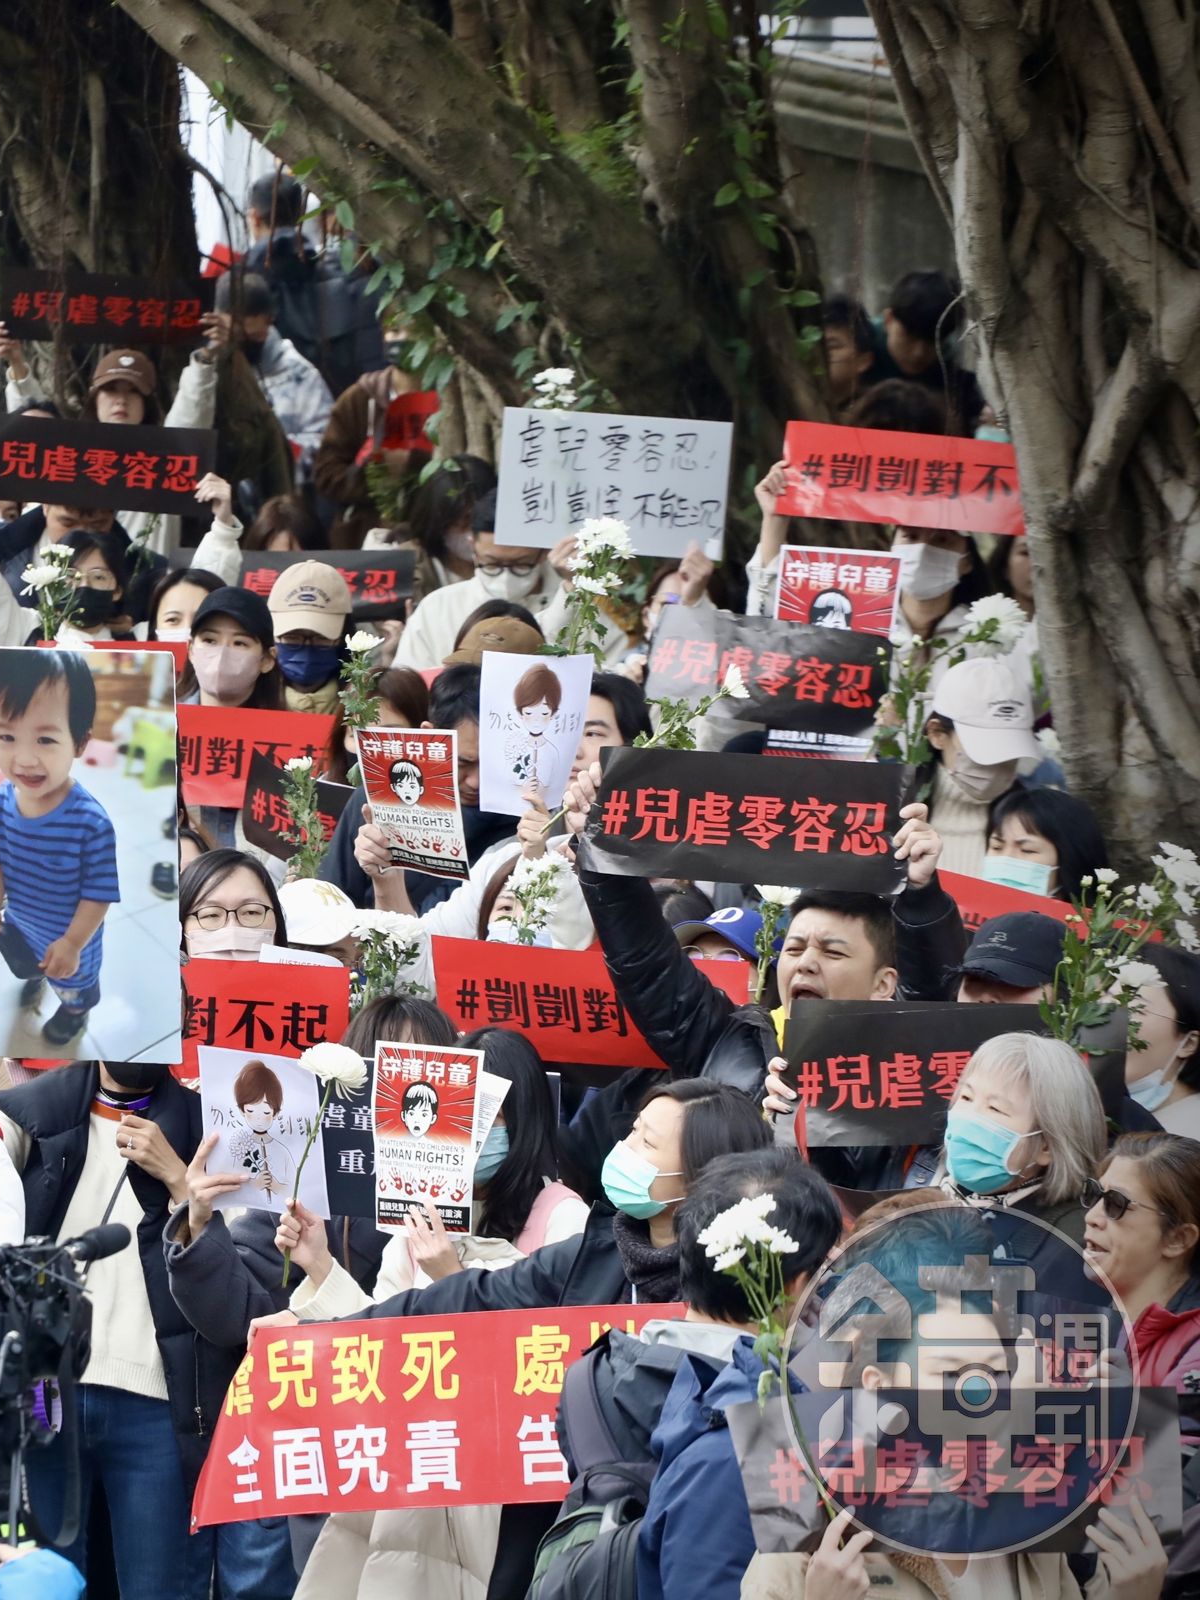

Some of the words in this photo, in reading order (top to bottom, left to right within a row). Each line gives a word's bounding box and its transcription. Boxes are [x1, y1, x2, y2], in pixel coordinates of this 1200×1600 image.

[11, 291, 202, 330] #兒虐零容忍
[784, 559, 893, 595] 守護兒童
[653, 638, 874, 709] #兒虐零容忍
[363, 738, 448, 761] 守護兒童
[374, 810, 410, 825] HUMAN
[412, 815, 455, 829] RIGHTS!
[601, 786, 890, 858] #兒虐零容忍
[382, 1056, 472, 1088] 守護兒童
[379, 1147, 412, 1161] HUMAN
[415, 1150, 464, 1166] RIGHTS!
[228, 1421, 462, 1504] 全面究責
[770, 1435, 1153, 1508] #兒虐零容忍
